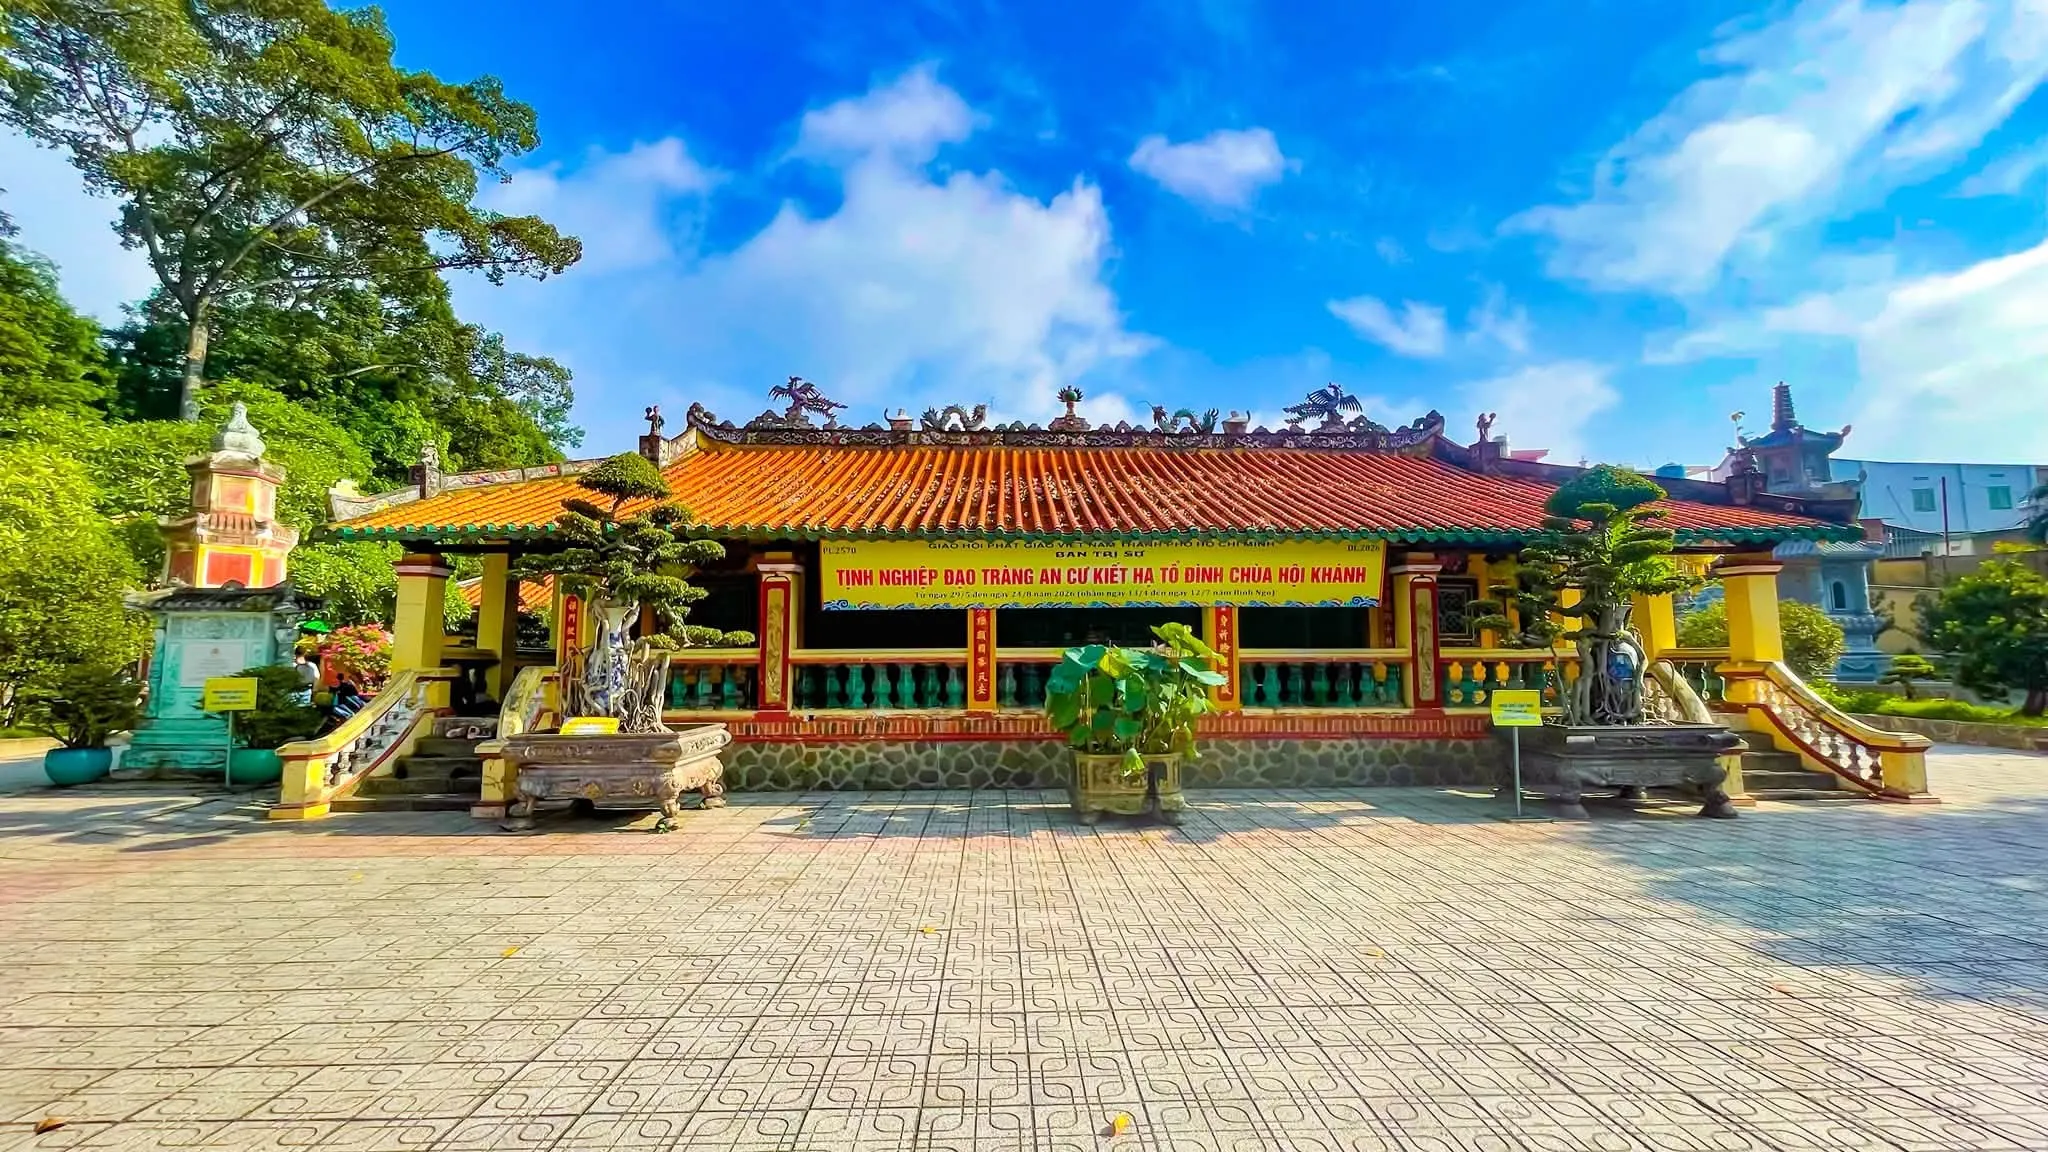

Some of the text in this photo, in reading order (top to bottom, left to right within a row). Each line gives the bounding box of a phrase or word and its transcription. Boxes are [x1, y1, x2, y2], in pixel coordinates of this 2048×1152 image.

[1055, 550, 1087, 558] BAN
[836, 569, 874, 590] TỊNH
[879, 565, 938, 590] NGHIỆP
[944, 568, 976, 589] ĐẠO
[981, 564, 1034, 586] TRÀNG
[1039, 567, 1062, 585] AN
[1066, 566, 1091, 585] CƯ
[1093, 561, 1128, 585] KIẾT
[1133, 567, 1154, 588] HẠ
[1185, 563, 1224, 584] ĐÌNH
[1229, 563, 1272, 584] CHÙA
[1278, 563, 1305, 588] HỘI
[1311, 563, 1367, 584] KHÁNH
